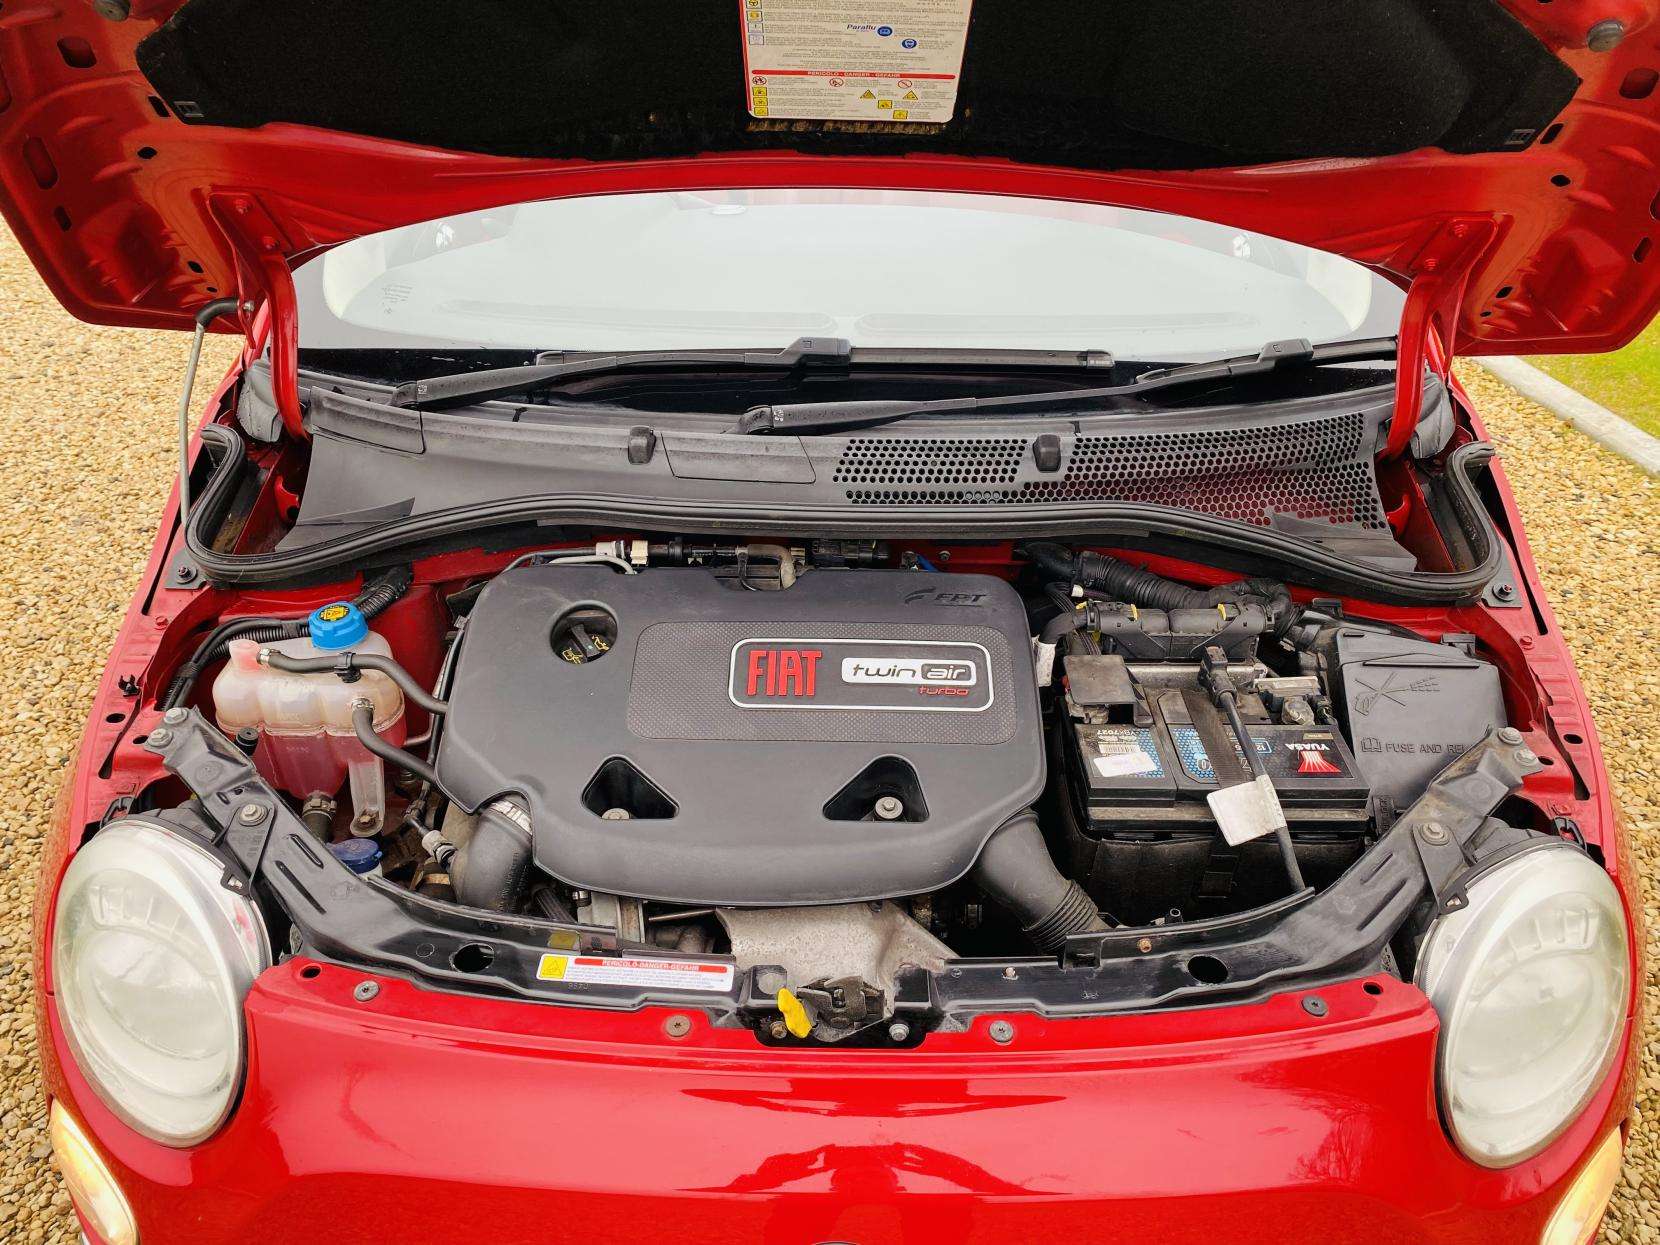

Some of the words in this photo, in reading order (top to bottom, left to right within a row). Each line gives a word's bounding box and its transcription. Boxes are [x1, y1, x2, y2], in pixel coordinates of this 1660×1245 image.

[746, 650, 822, 697] FIAT
[852, 663, 917, 679] twin
[926, 663, 967, 680] air
[918, 686, 969, 696] turbo
[1285, 743, 1330, 752] YUASA
[1384, 743, 1415, 754] FUSE
[1419, 744, 1443, 754] AND
